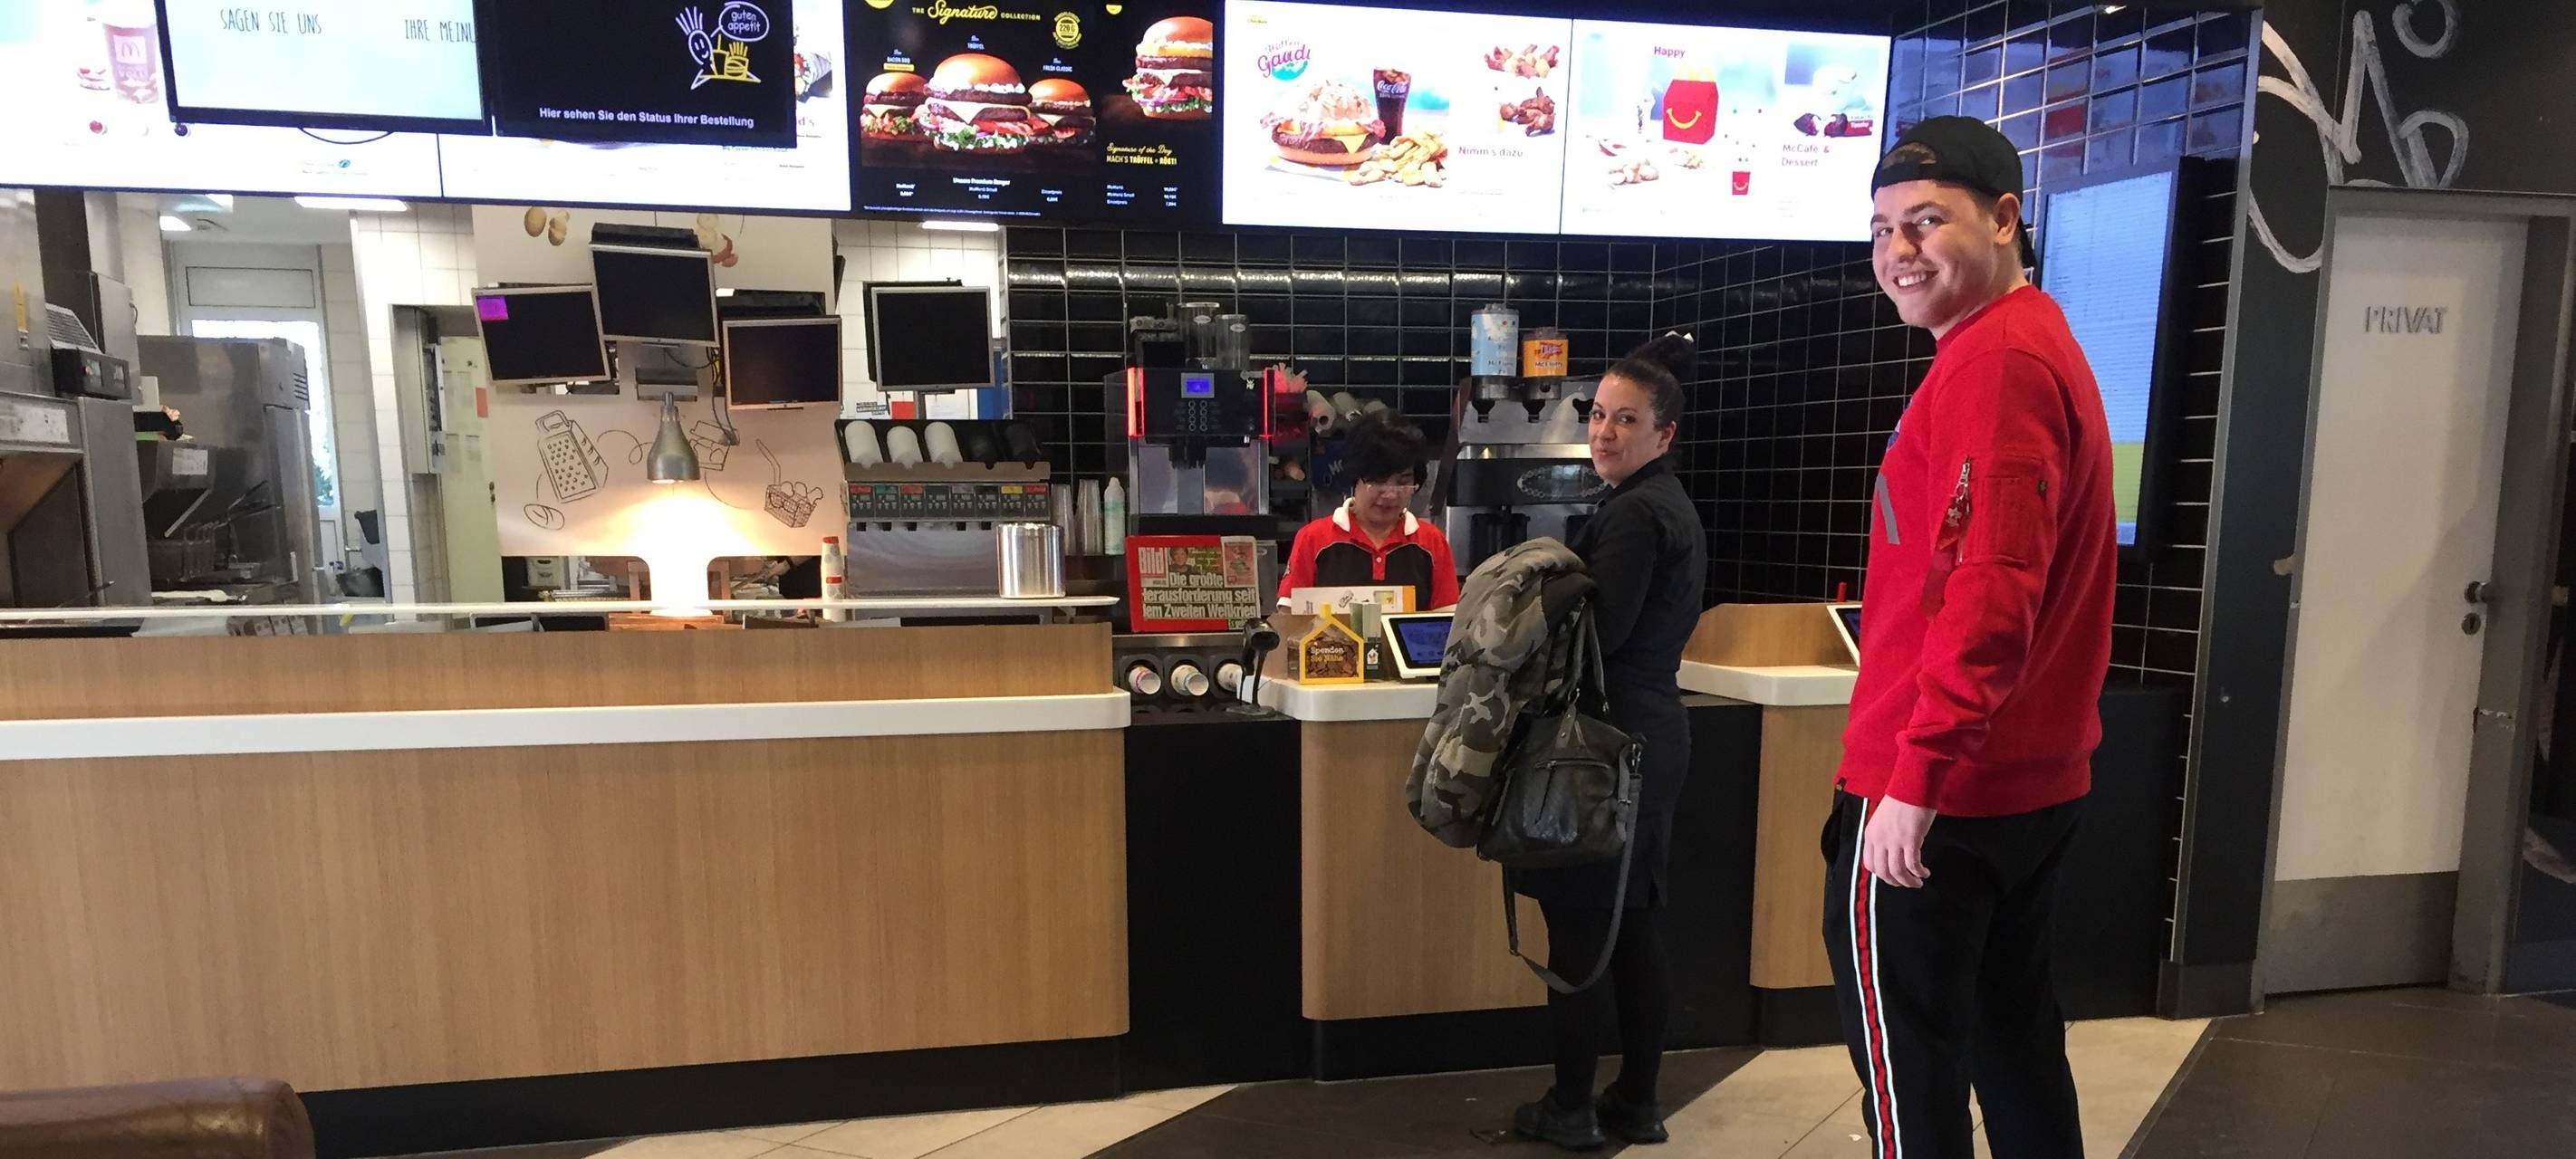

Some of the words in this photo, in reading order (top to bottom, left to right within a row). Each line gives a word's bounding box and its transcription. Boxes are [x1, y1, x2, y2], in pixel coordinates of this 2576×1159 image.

[220, 8, 259, 32] SAGEN
[268, 11, 288, 34] SIE
[297, 14, 322, 34] UNS
[731, 10, 756, 24] guten
[928, 0, 997, 24] Signature
[1001, 12, 1041, 21] COLLECTION
[405, 19, 430, 41] IHRE
[727, 21, 761, 34] appetit
[1654, 46, 1686, 58] Happy
[540, 108, 562, 119] Hier
[563, 110, 595, 120] sehen
[598, 110, 614, 120] Sie
[617, 111, 636, 121] den
[639, 111, 671, 123] Status
[674, 113, 697, 124] Ihrer
[700, 114, 755, 129] Bestellung
[2365, 306, 2446, 334] PRIVAT
[1139, 547, 1165, 574] Bild
[1169, 573, 1186, 586] Die
[1189, 572, 1223, 589] größte
[1235, 589, 1255, 602] seit
[1164, 604, 1206, 618] Zweiten
[1207, 603, 1256, 618] Weltkrieg
